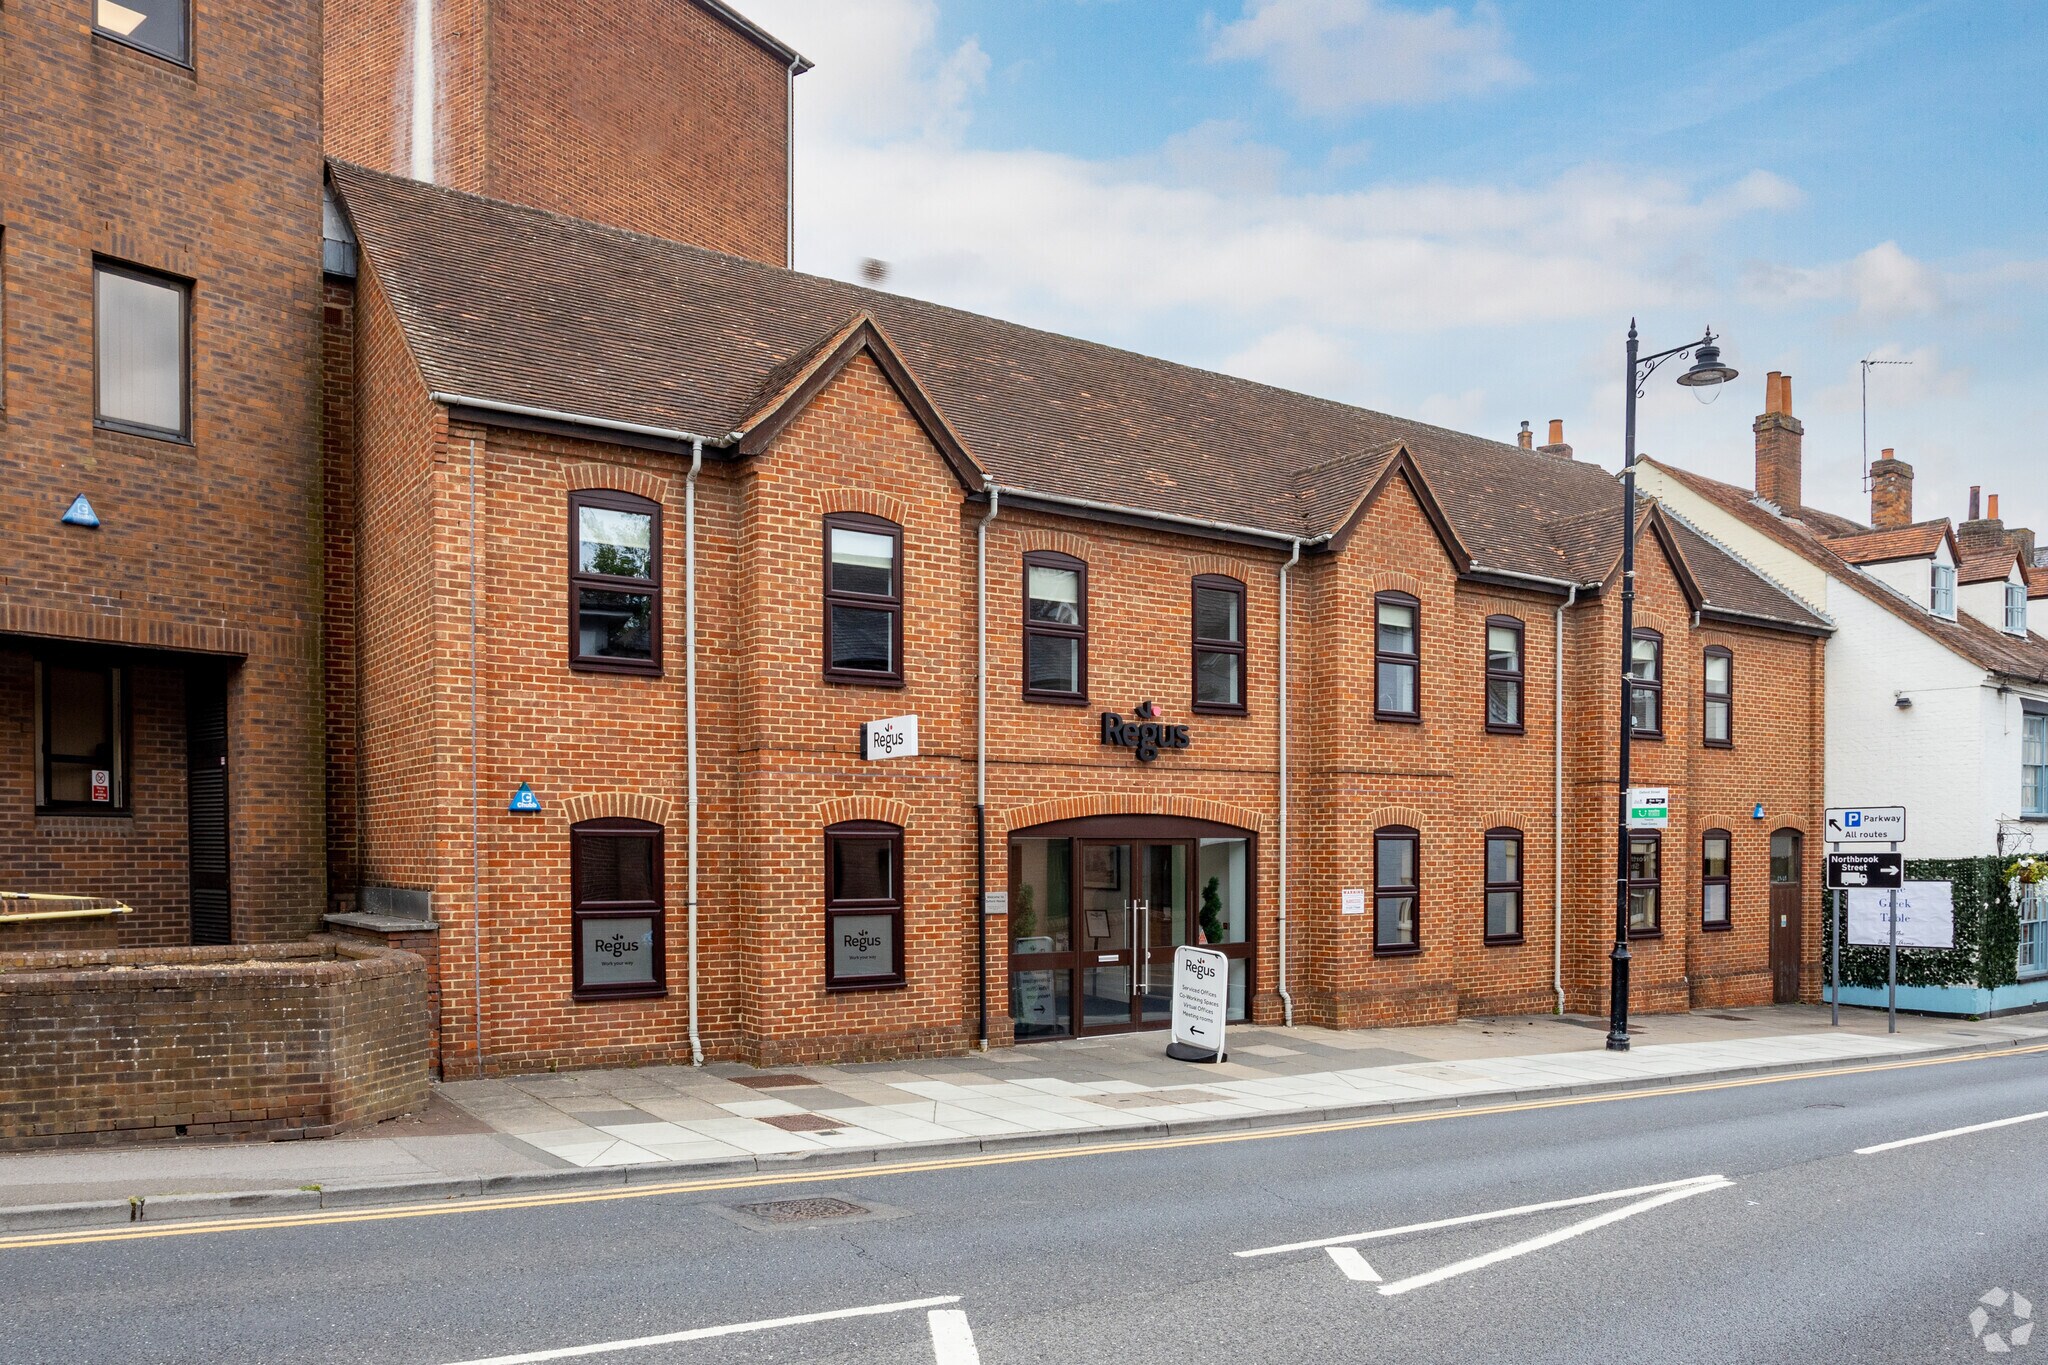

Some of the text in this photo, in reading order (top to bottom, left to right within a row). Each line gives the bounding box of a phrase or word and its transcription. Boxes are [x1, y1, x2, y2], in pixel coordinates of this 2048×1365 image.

[1101, 711, 1190, 761] Regus
[873, 732, 904, 754] Regus
[1848, 813, 1901, 826] P Parkway
[1831, 855, 1879, 863] Northbrook
[1879, 898, 1911, 908] Grek
[595, 939, 639, 958] Regus
[844, 934, 881, 952] Regus
[1185, 959, 1215, 979] Regus
[1182, 985, 1216, 998] Serviced Offices
[1179, 993, 1219, 1007] Co-Working Spaces
[1183, 1002, 1214, 1014] Virtual Offices
[1182, 1010, 1198, 1020] Meeting
